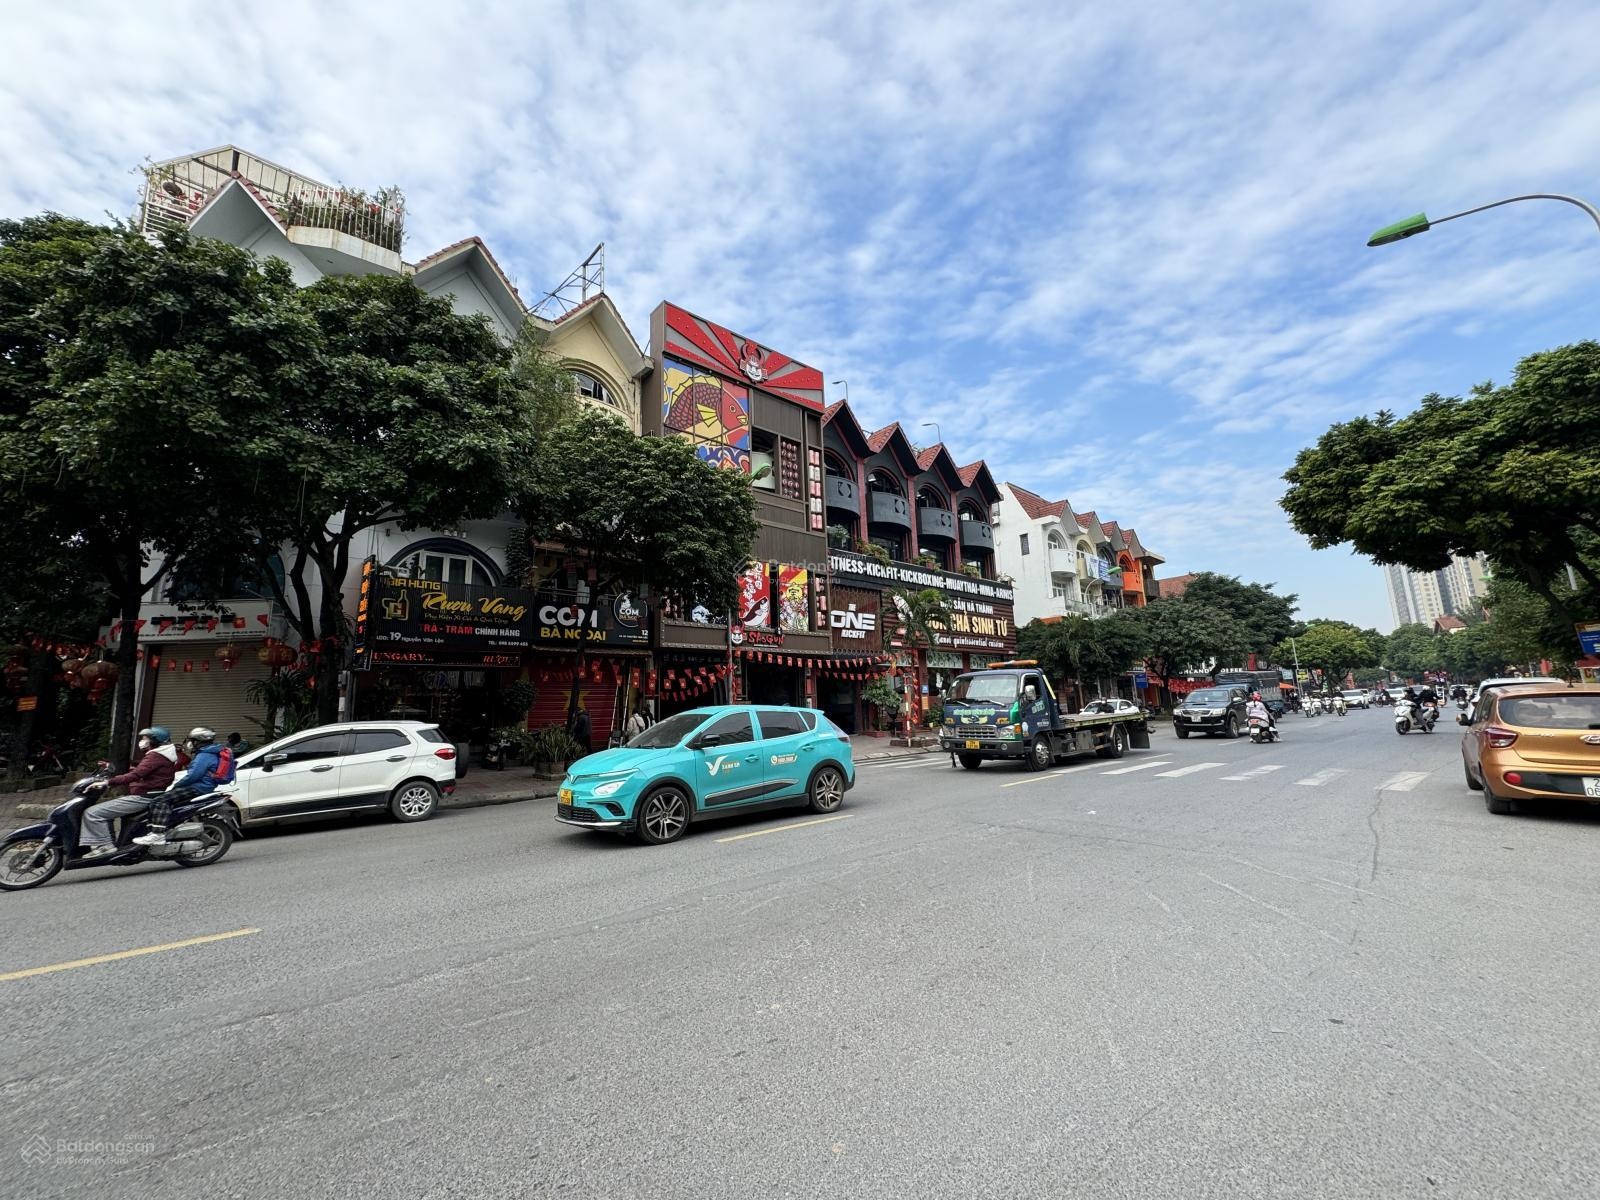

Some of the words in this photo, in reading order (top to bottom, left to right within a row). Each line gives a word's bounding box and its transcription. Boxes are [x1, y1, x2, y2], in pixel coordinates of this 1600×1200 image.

[831, 610, 876, 631] ONE
[972, 616, 995, 635] SINH
[389, 631, 402, 641] 19
[475, 626, 499, 636] CHÍNH
[540, 624, 561, 638] BÀ
